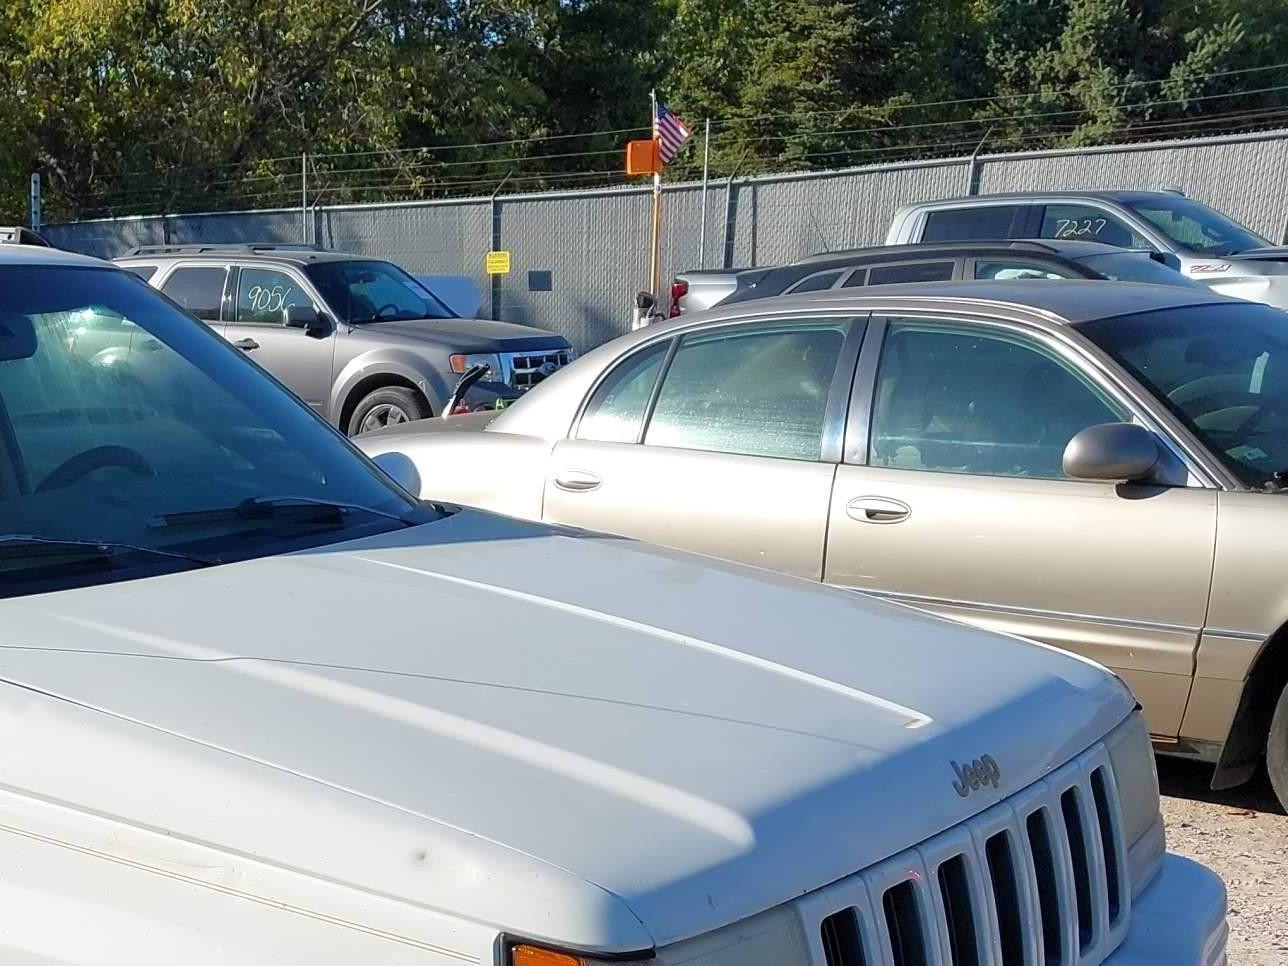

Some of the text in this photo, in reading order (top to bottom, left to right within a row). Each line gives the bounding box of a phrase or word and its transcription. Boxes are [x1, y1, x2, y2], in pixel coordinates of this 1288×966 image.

[1054, 219, 1107, 238] 7227
[248, 285, 296, 313] 9056
[950, 753, 1001, 798] Jeep
